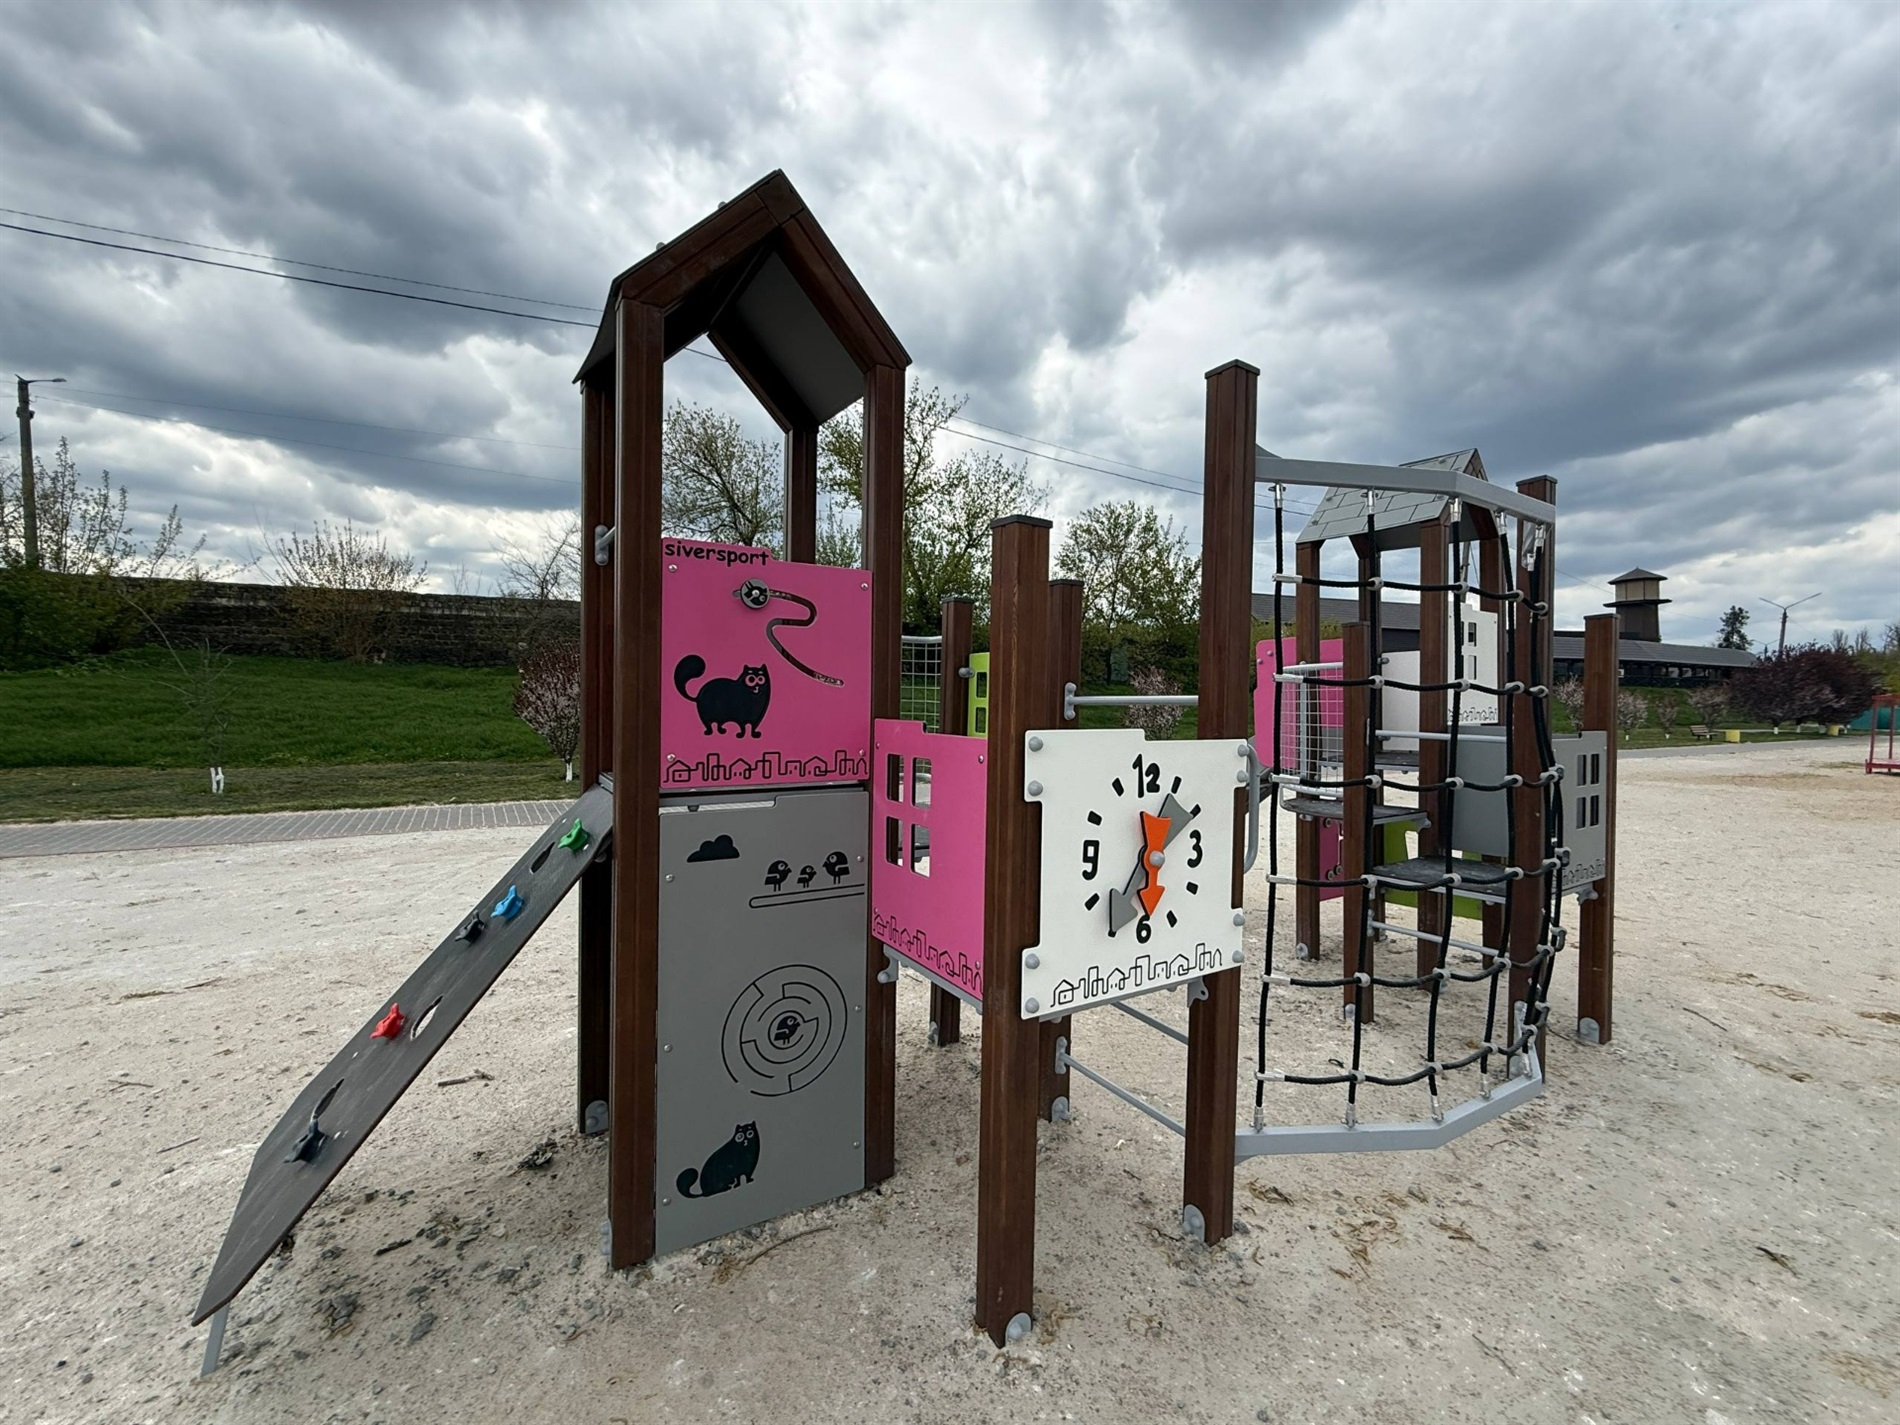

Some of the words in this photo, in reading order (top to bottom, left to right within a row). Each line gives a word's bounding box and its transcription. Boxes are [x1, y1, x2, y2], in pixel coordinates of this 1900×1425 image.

[664, 542, 769, 567] siversport
[1132, 753, 1161, 798] 12
[1082, 839, 1099, 880] 9
[1187, 830, 1203, 868] 3
[1136, 914, 1151, 944] 6
